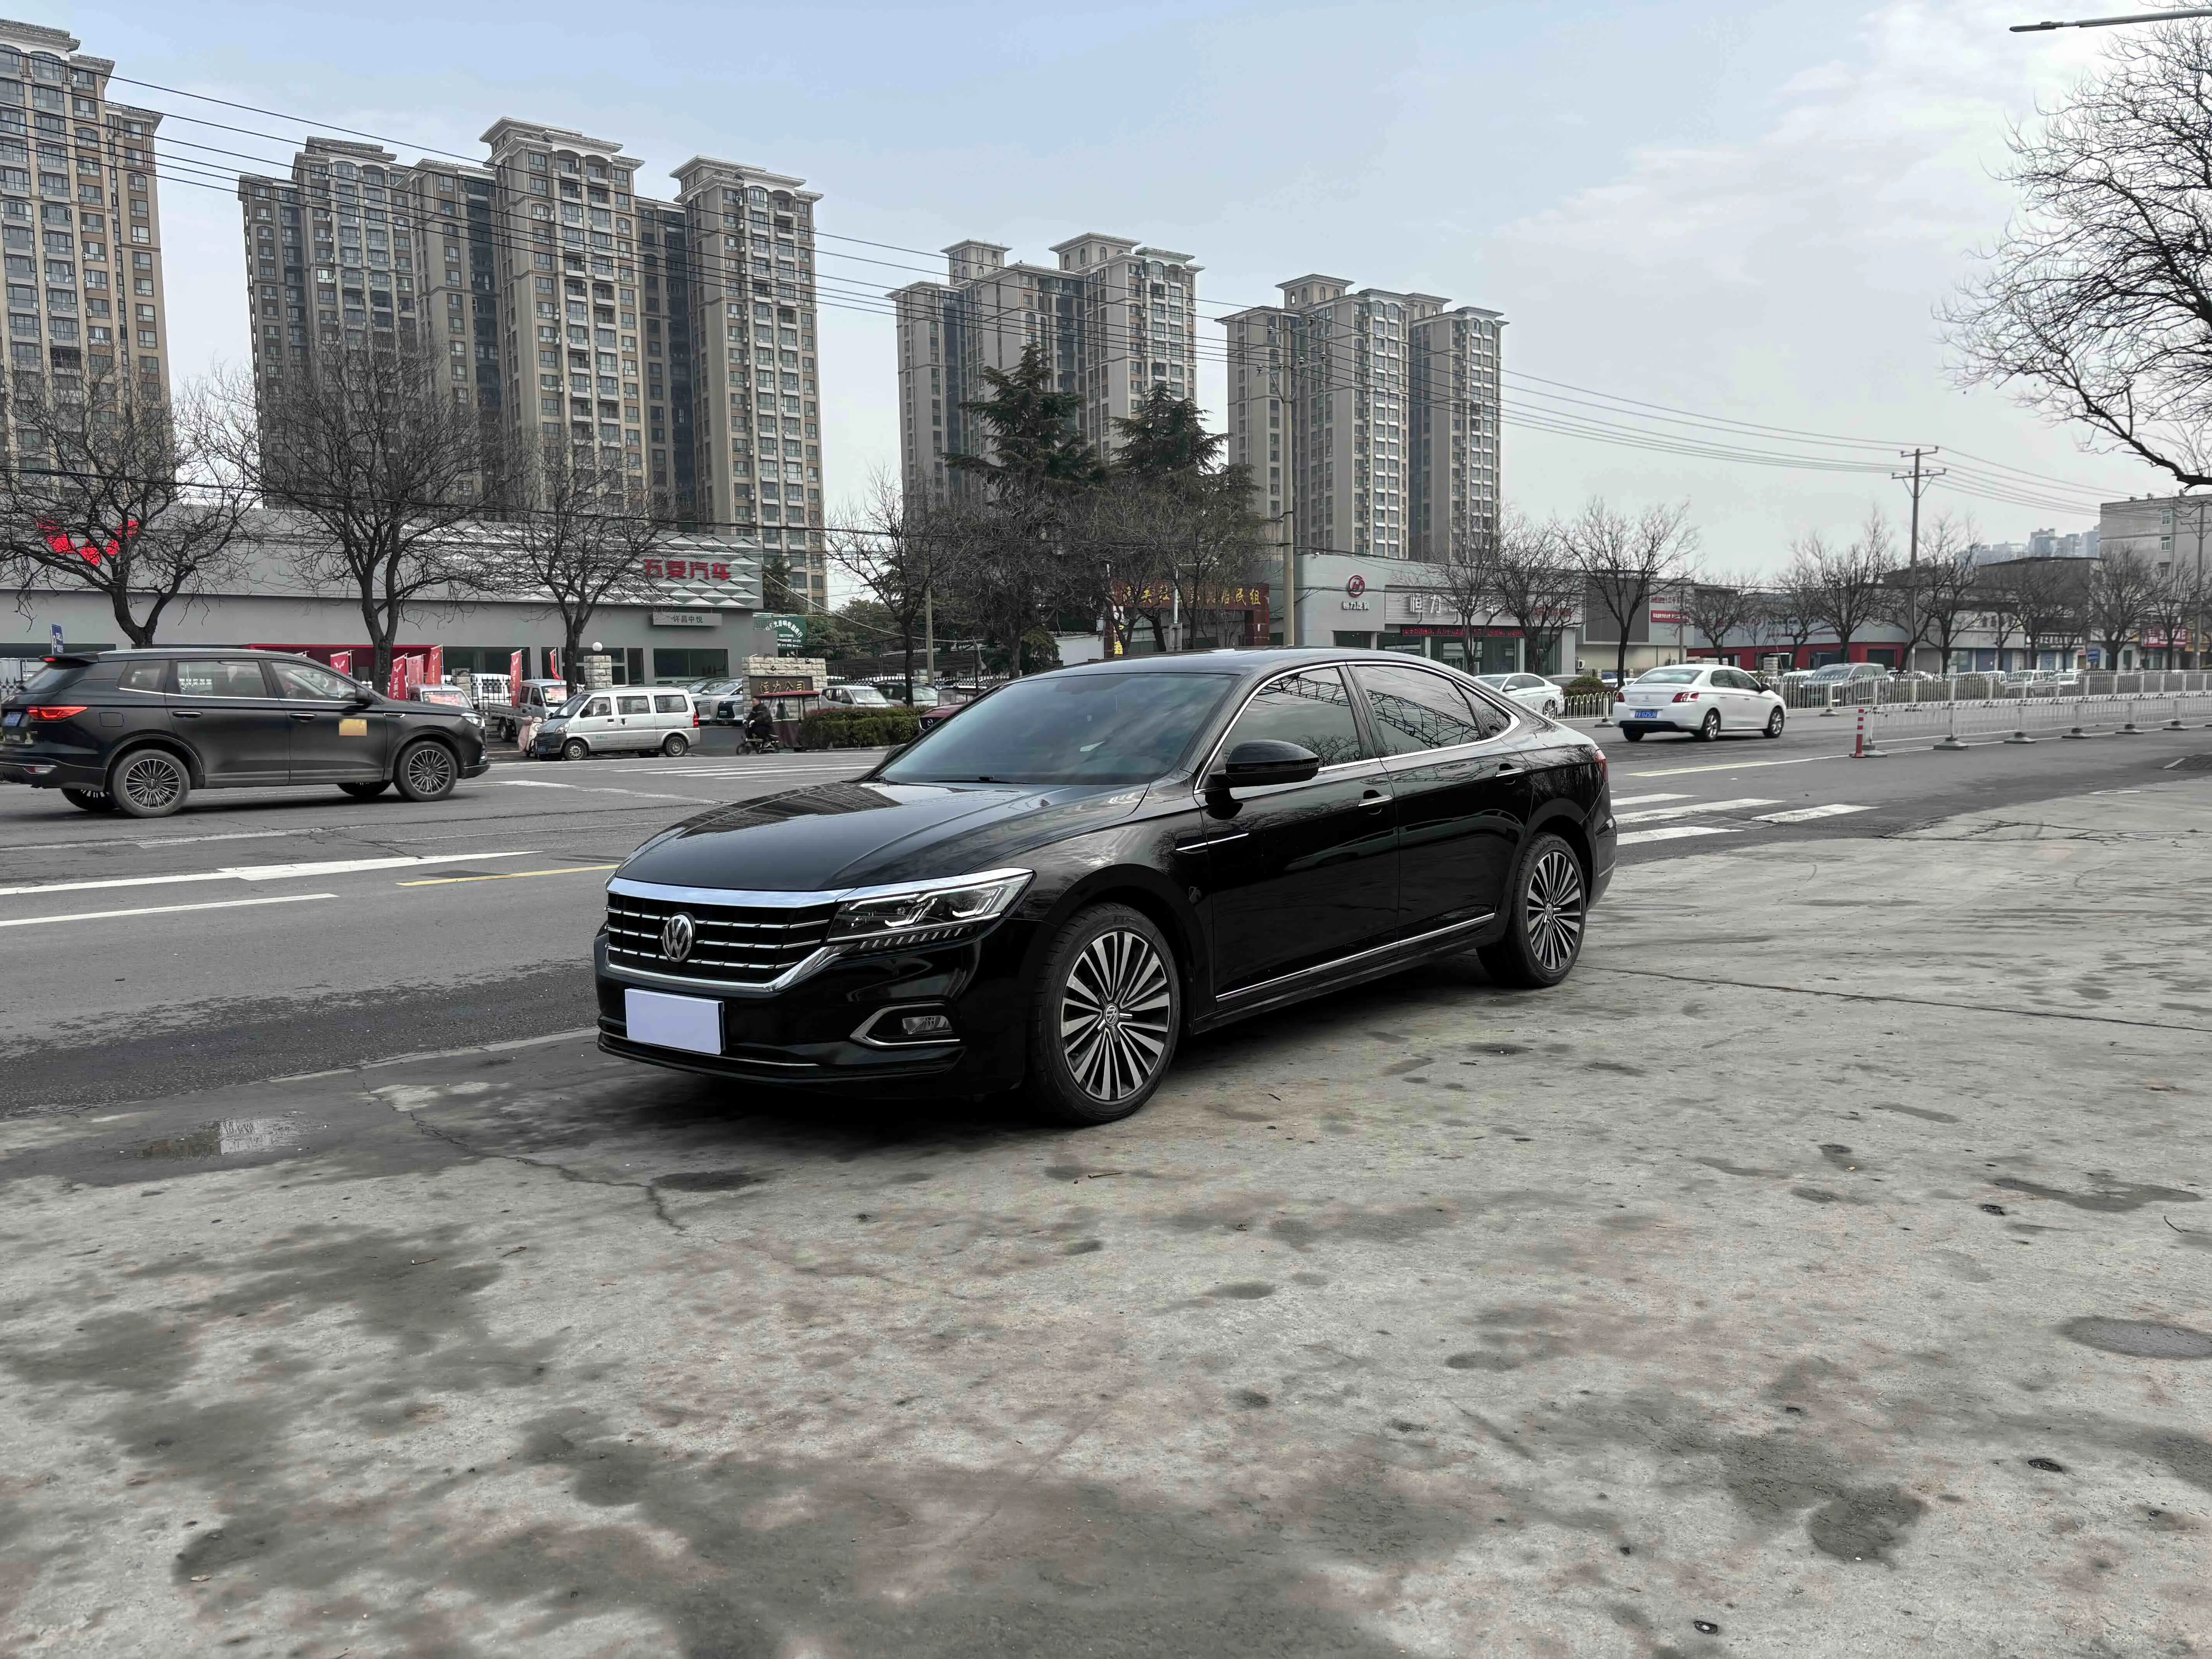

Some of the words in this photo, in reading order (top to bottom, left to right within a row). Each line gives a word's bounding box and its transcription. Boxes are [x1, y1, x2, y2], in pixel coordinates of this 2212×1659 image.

[643, 559, 732, 580] 五菱汽车
[673, 614, 703, 623] 许昌中悦
[759, 680, 805, 694] 恒力公司
